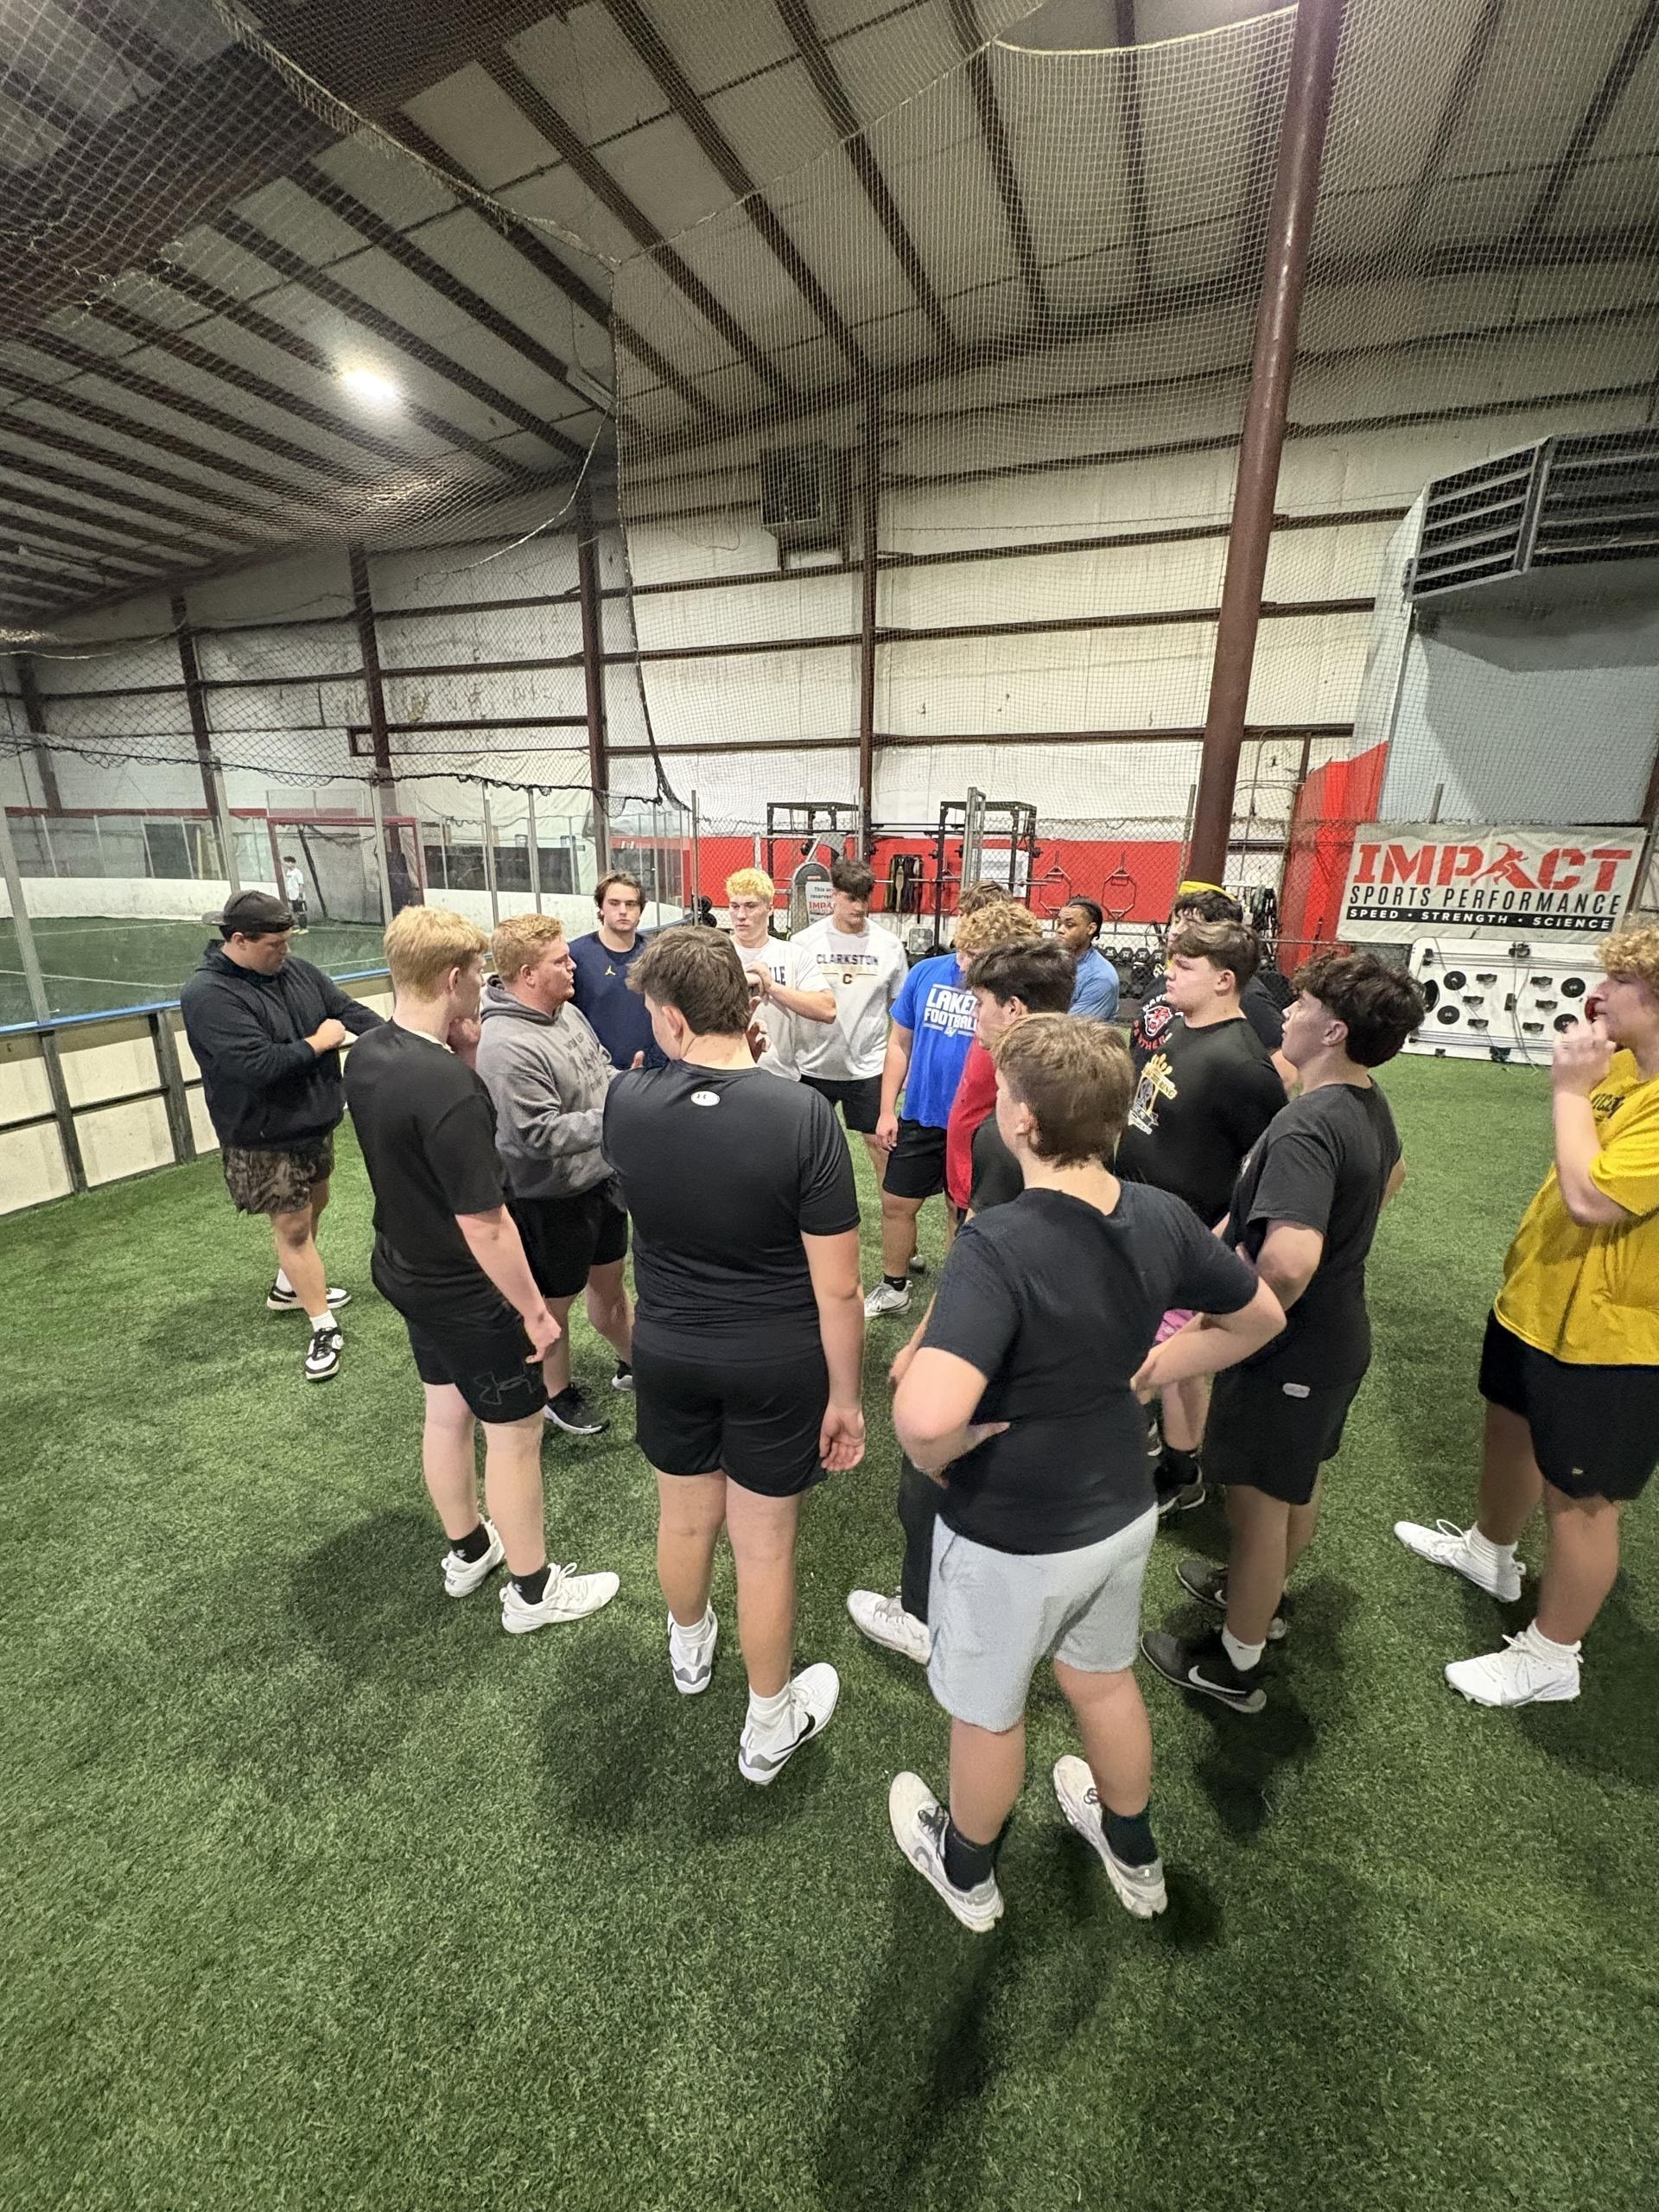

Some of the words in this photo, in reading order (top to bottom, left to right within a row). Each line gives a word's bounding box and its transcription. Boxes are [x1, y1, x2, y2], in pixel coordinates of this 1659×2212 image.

[1353, 842, 1632, 892] IMPACT
[1350, 886, 1431, 906] SPORTS
[1443, 888, 1621, 915] PERFORMANCE
[1350, 909, 1398, 918] SPEED
[1421, 912, 1508, 924] STRENGTH
[1533, 917, 1611, 930] SCIENCE
[816, 954, 879, 965] CLARKSTON
[842, 974, 852, 984] C
[926, 988, 978, 1015] LAKE
